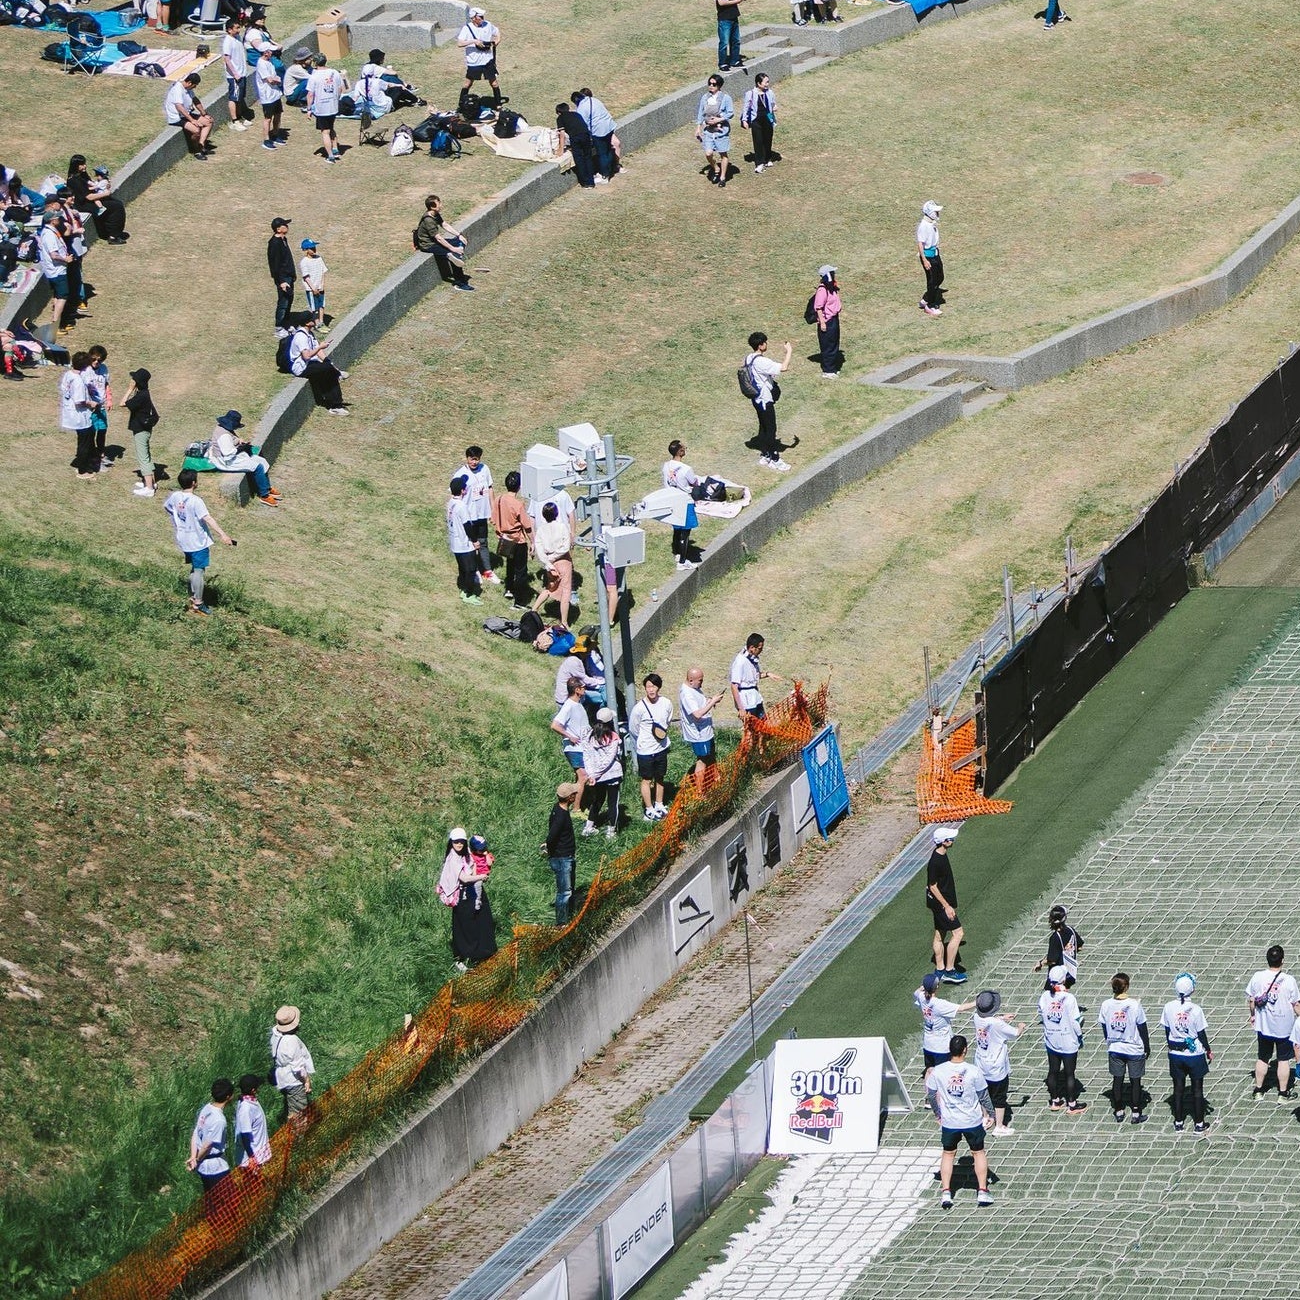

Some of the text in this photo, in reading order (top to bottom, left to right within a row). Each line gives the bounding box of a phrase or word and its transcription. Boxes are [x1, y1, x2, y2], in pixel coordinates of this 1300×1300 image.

[791, 1070, 863, 1096] 300m
[789, 1111, 843, 1129] Red Bull
[615, 1202, 668, 1263] DEFENDER
